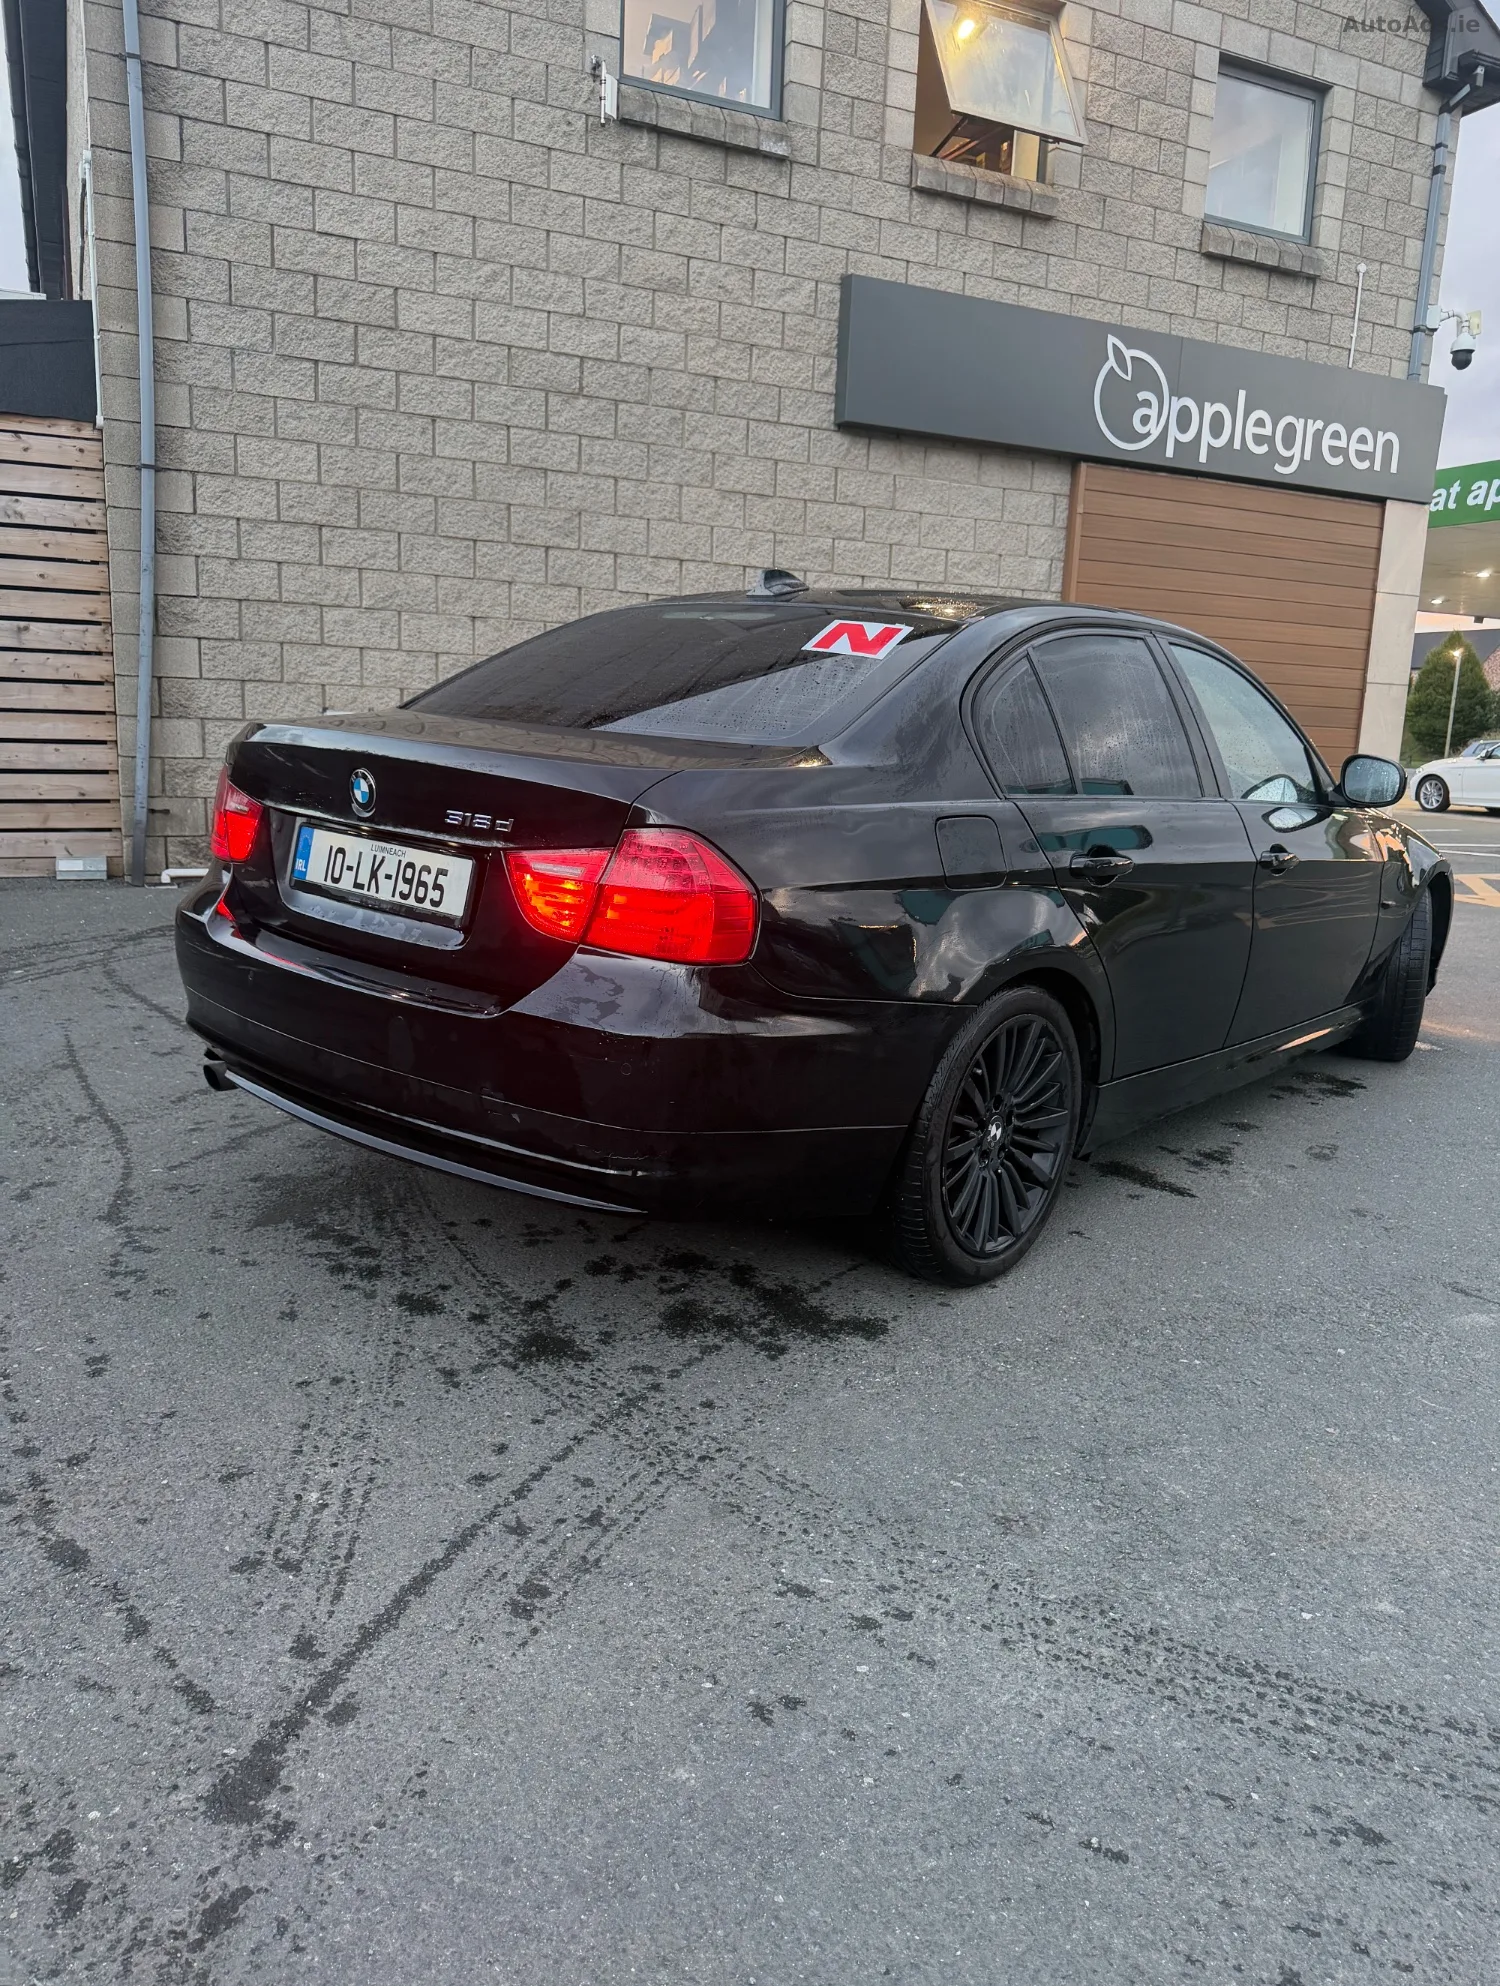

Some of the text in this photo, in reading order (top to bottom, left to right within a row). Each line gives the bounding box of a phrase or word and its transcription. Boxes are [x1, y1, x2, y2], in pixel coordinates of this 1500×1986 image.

[1132, 389, 1400, 475] applegreen
[1430, 479, 1461, 512] at
[812, 623, 903, 655] N
[294, 858, 306, 871] IRL
[371, 844, 406, 858] LUIMNEACH
[323, 845, 448, 908] 10-LK-1965
